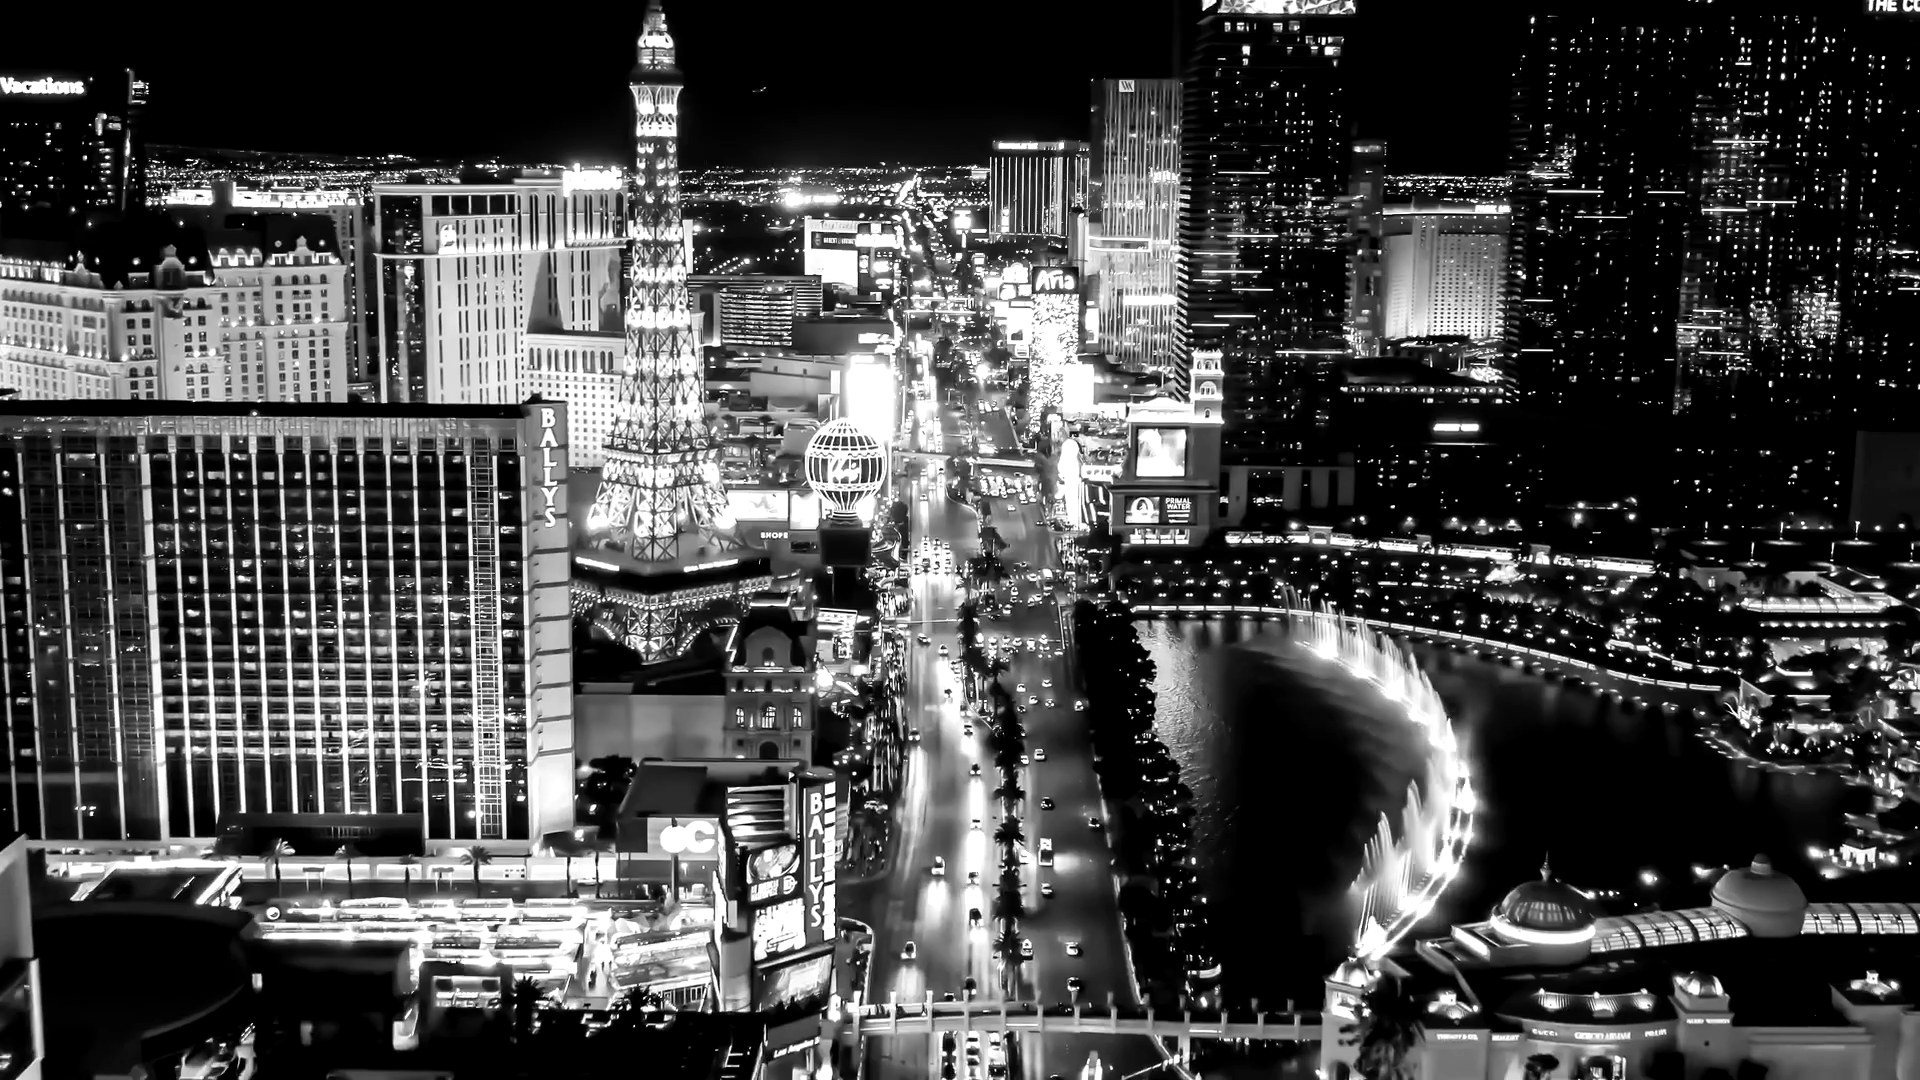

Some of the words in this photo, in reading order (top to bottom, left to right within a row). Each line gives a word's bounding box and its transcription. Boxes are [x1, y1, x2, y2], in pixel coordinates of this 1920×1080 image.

[0, 76, 85, 94] Vacations
[1035, 269, 1075, 292] Aria
[1165, 497, 1192, 505] PRIMAL
